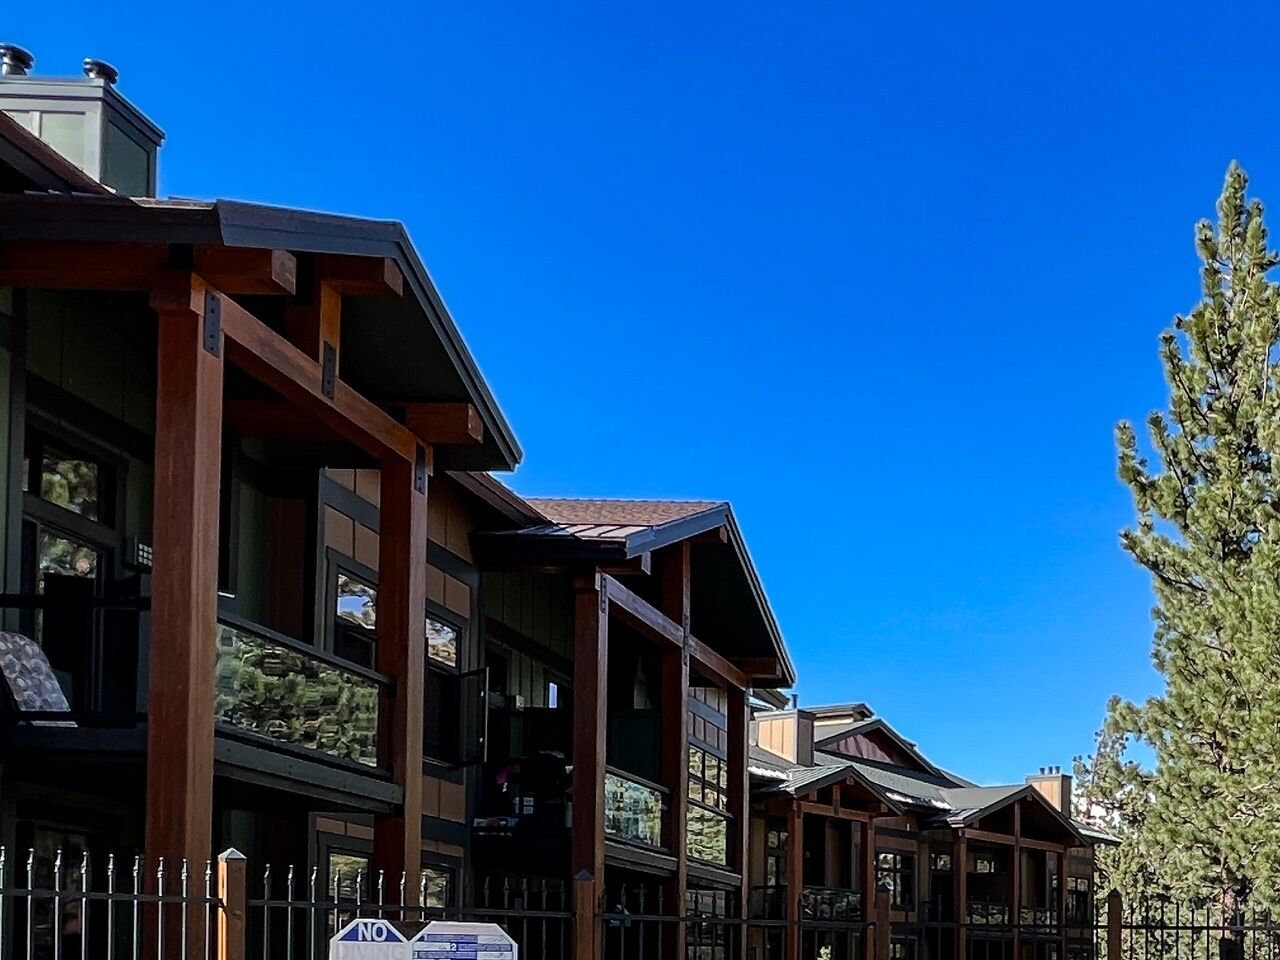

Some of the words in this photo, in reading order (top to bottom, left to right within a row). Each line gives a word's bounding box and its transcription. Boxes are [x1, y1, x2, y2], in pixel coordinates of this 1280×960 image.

[358, 922, 388, 942] NO
[335, 943, 406, 960] DIVING
[450, 943, 457, 951] 2
